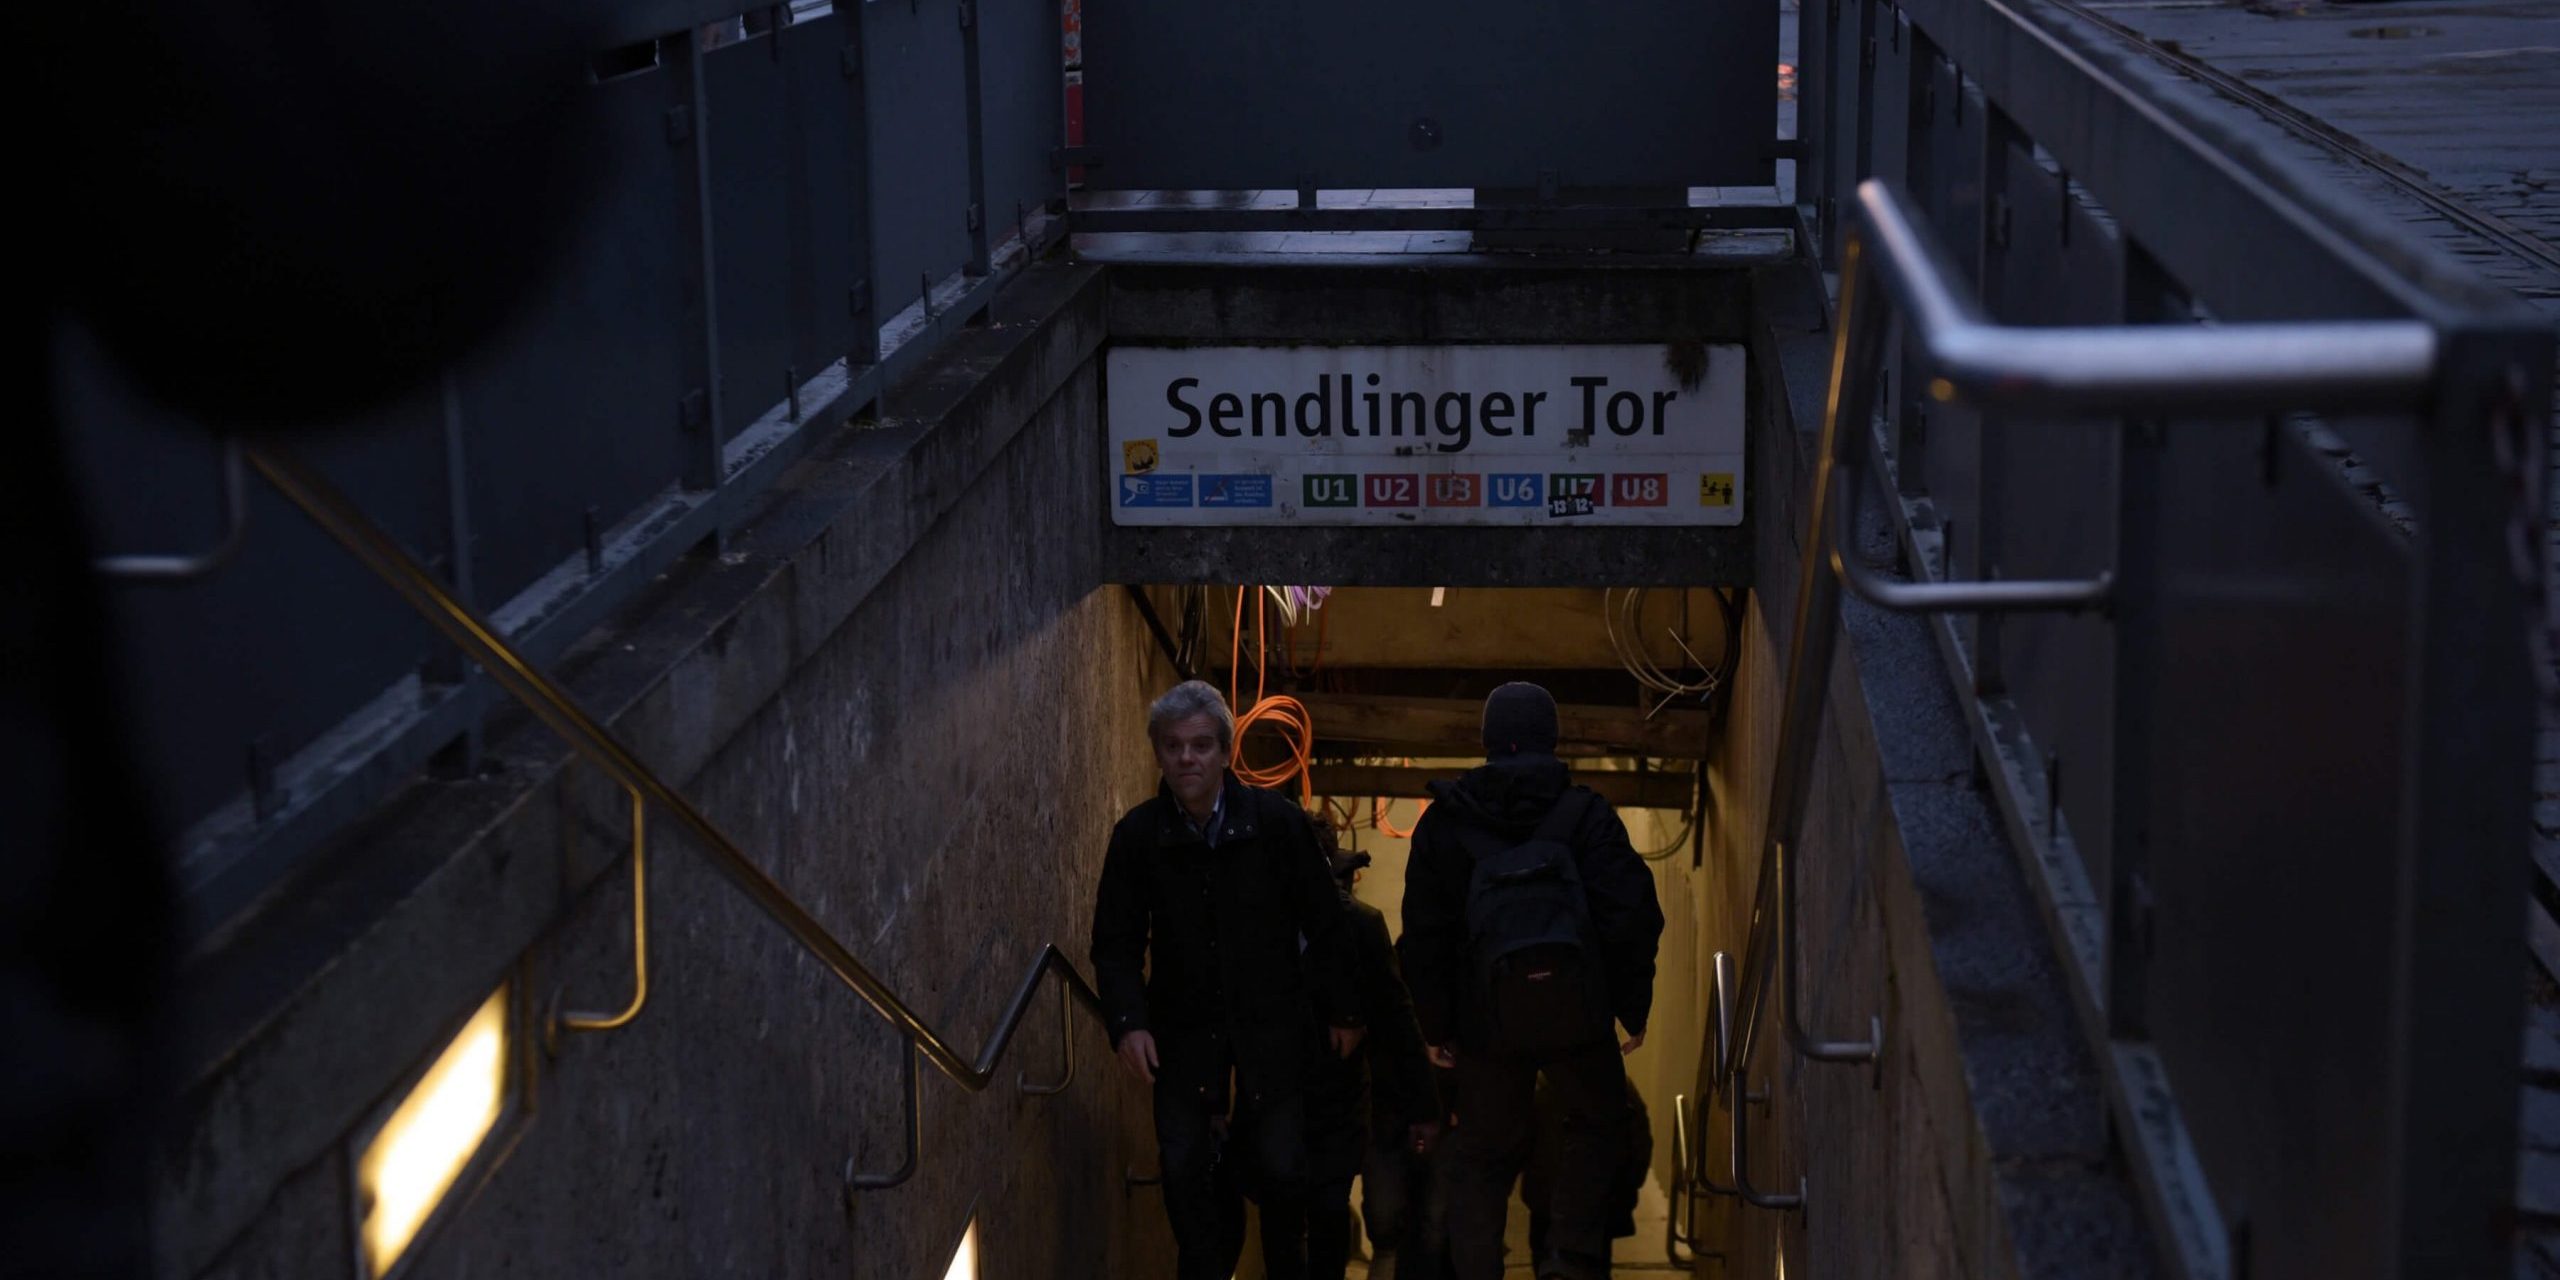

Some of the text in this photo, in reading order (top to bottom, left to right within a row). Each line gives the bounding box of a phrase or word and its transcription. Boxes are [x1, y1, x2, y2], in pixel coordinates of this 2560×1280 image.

[1167, 374, 1677, 452] Sendlinger Tor
[1311, 478, 1350, 502] U1
[1373, 478, 1411, 502] U2
[1434, 478, 1472, 502] U3
[1496, 478, 1535, 502] U6
[1621, 478, 1660, 502] U8
